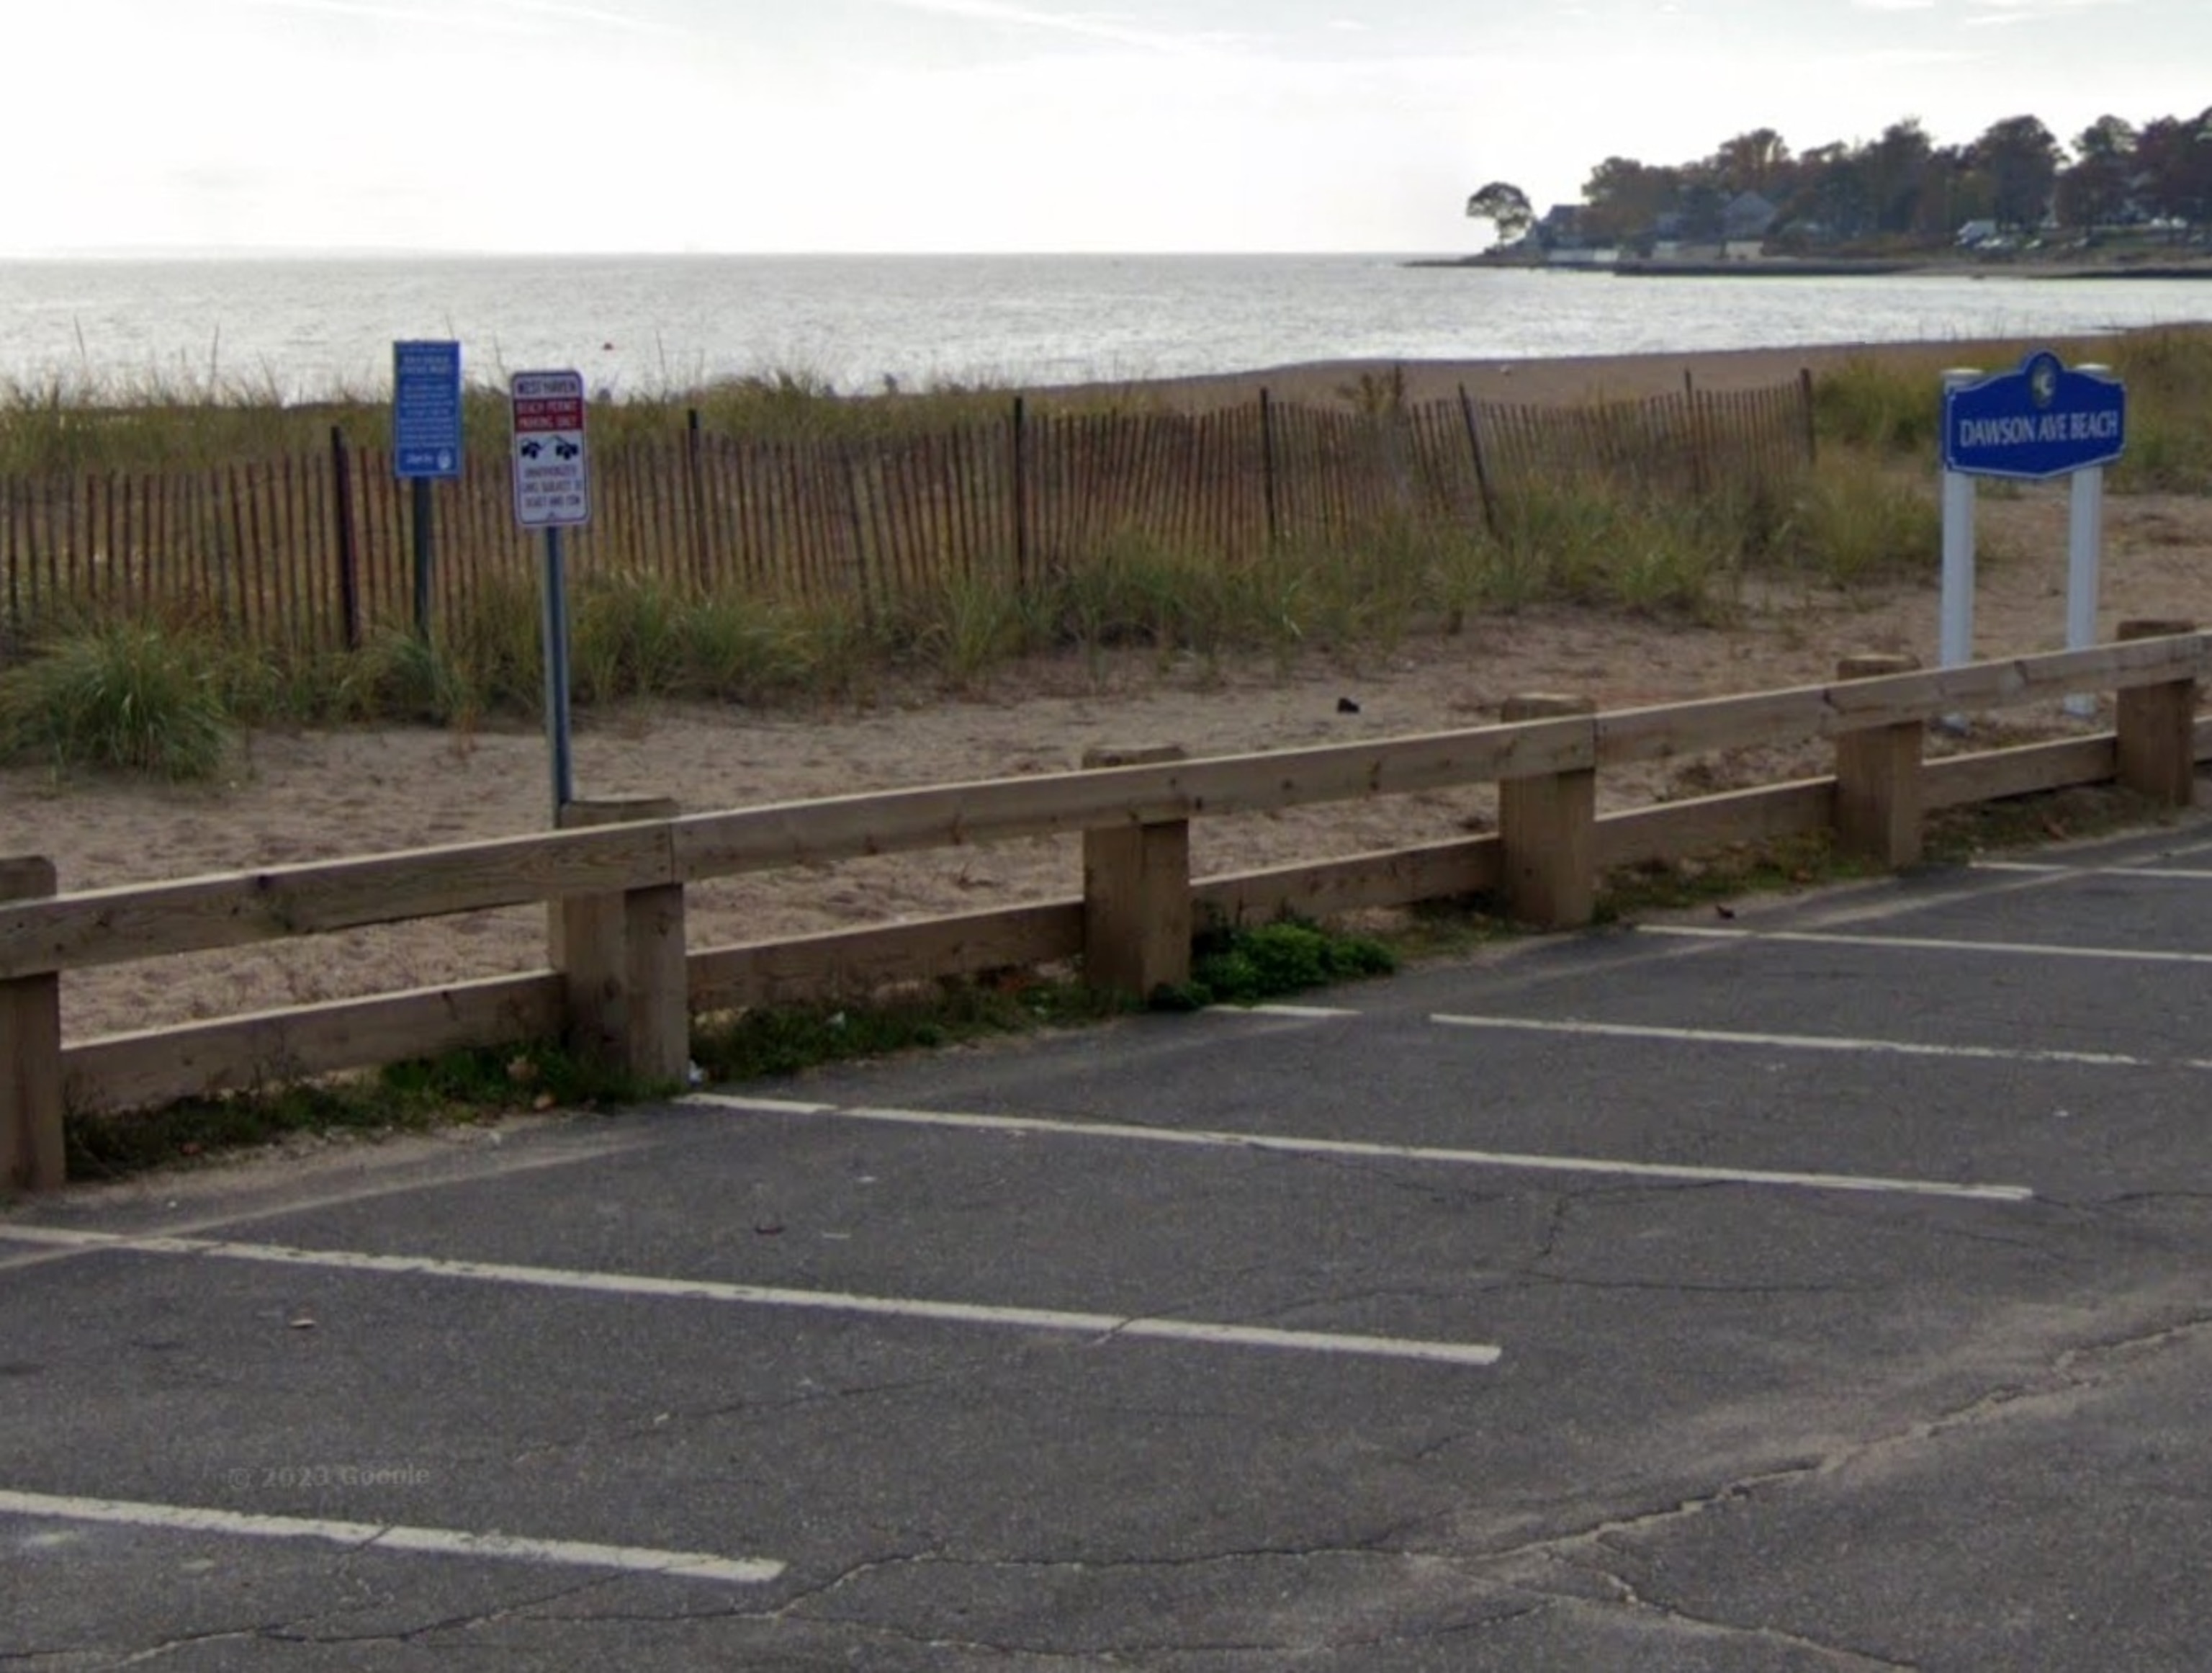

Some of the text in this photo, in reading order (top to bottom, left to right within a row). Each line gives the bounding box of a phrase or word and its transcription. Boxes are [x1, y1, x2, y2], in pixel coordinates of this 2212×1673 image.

[1959, 410, 2119, 448] DAWSON AVE BEACH
